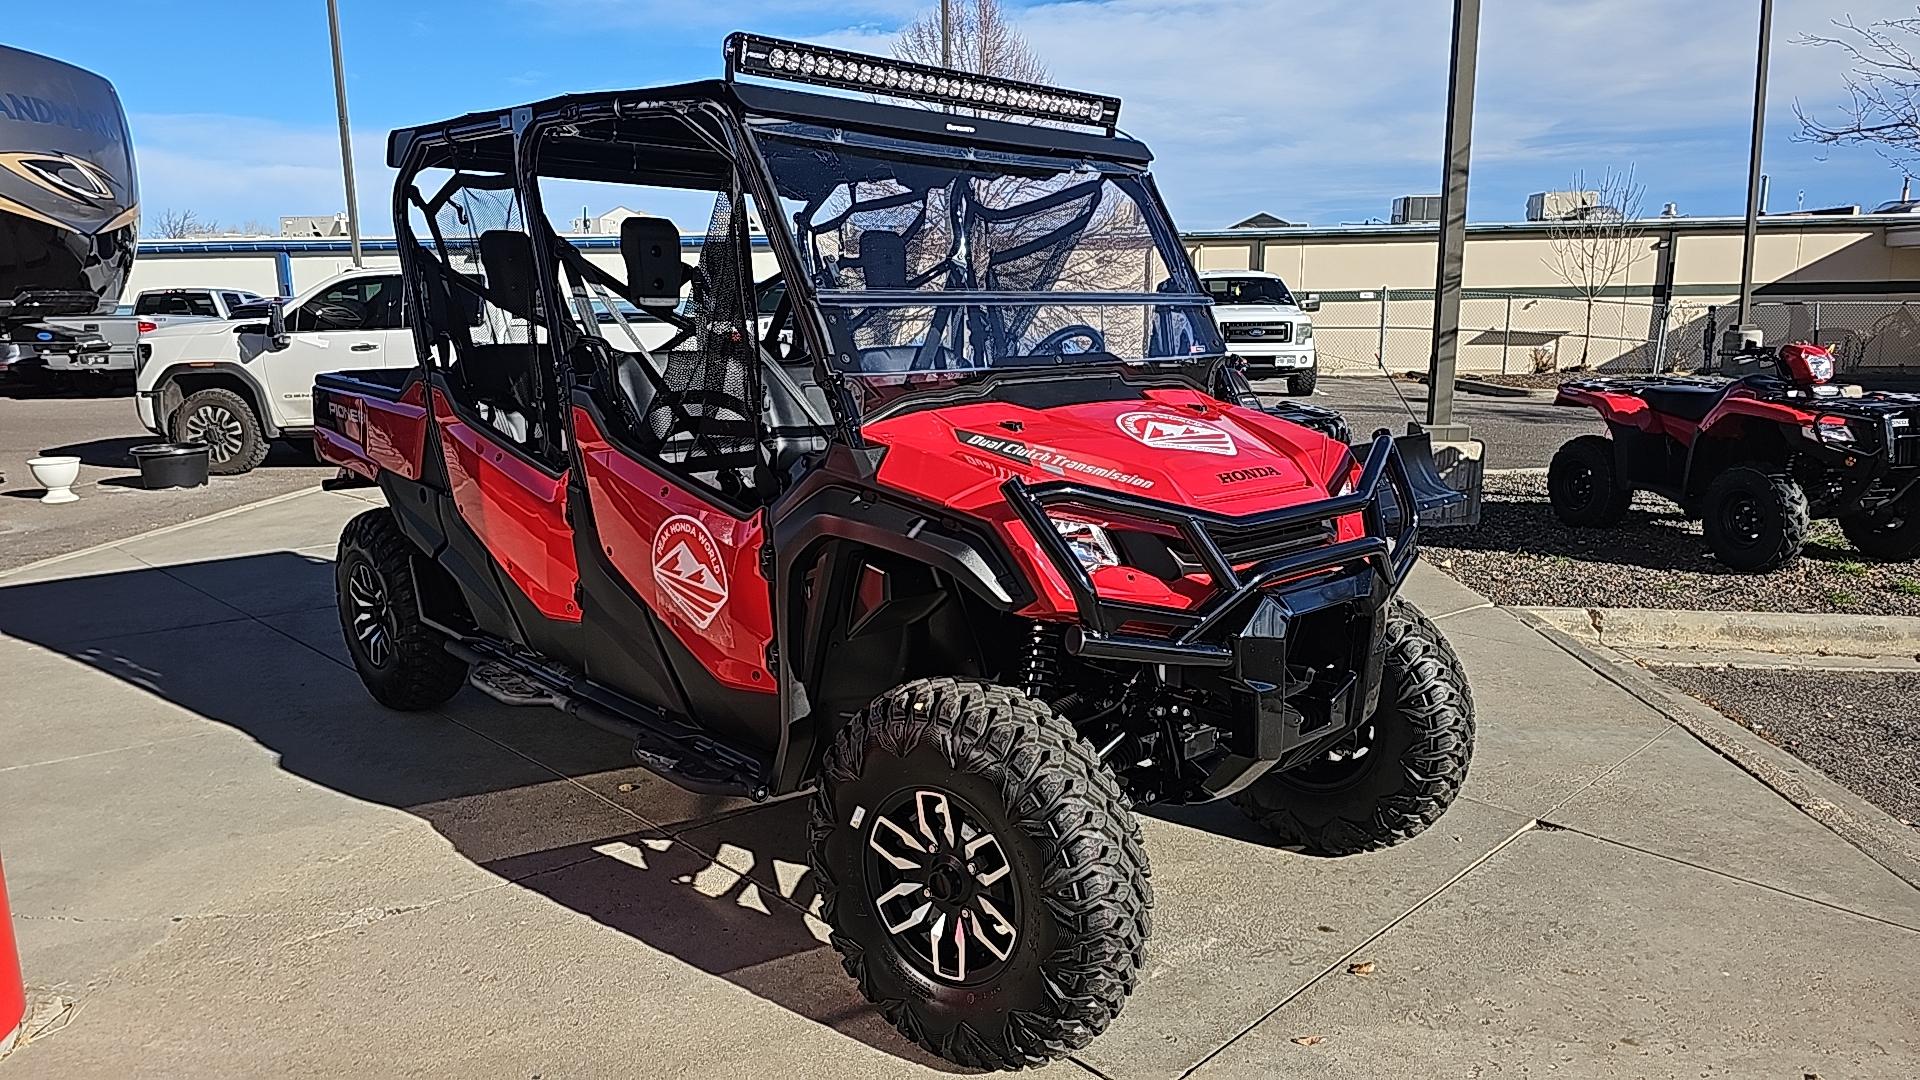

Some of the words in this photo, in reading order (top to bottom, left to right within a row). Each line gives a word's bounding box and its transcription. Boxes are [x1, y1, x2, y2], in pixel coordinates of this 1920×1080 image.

[967, 434, 1003, 450] Dual
[1003, 442, 1051, 462] Clutch
[1052, 453, 1155, 489] Transmission
[1216, 465, 1281, 484] HONDA
[656, 530, 671, 556] PEAK
[670, 522, 697, 538] HONDA
[698, 532, 720, 575] WORLD
